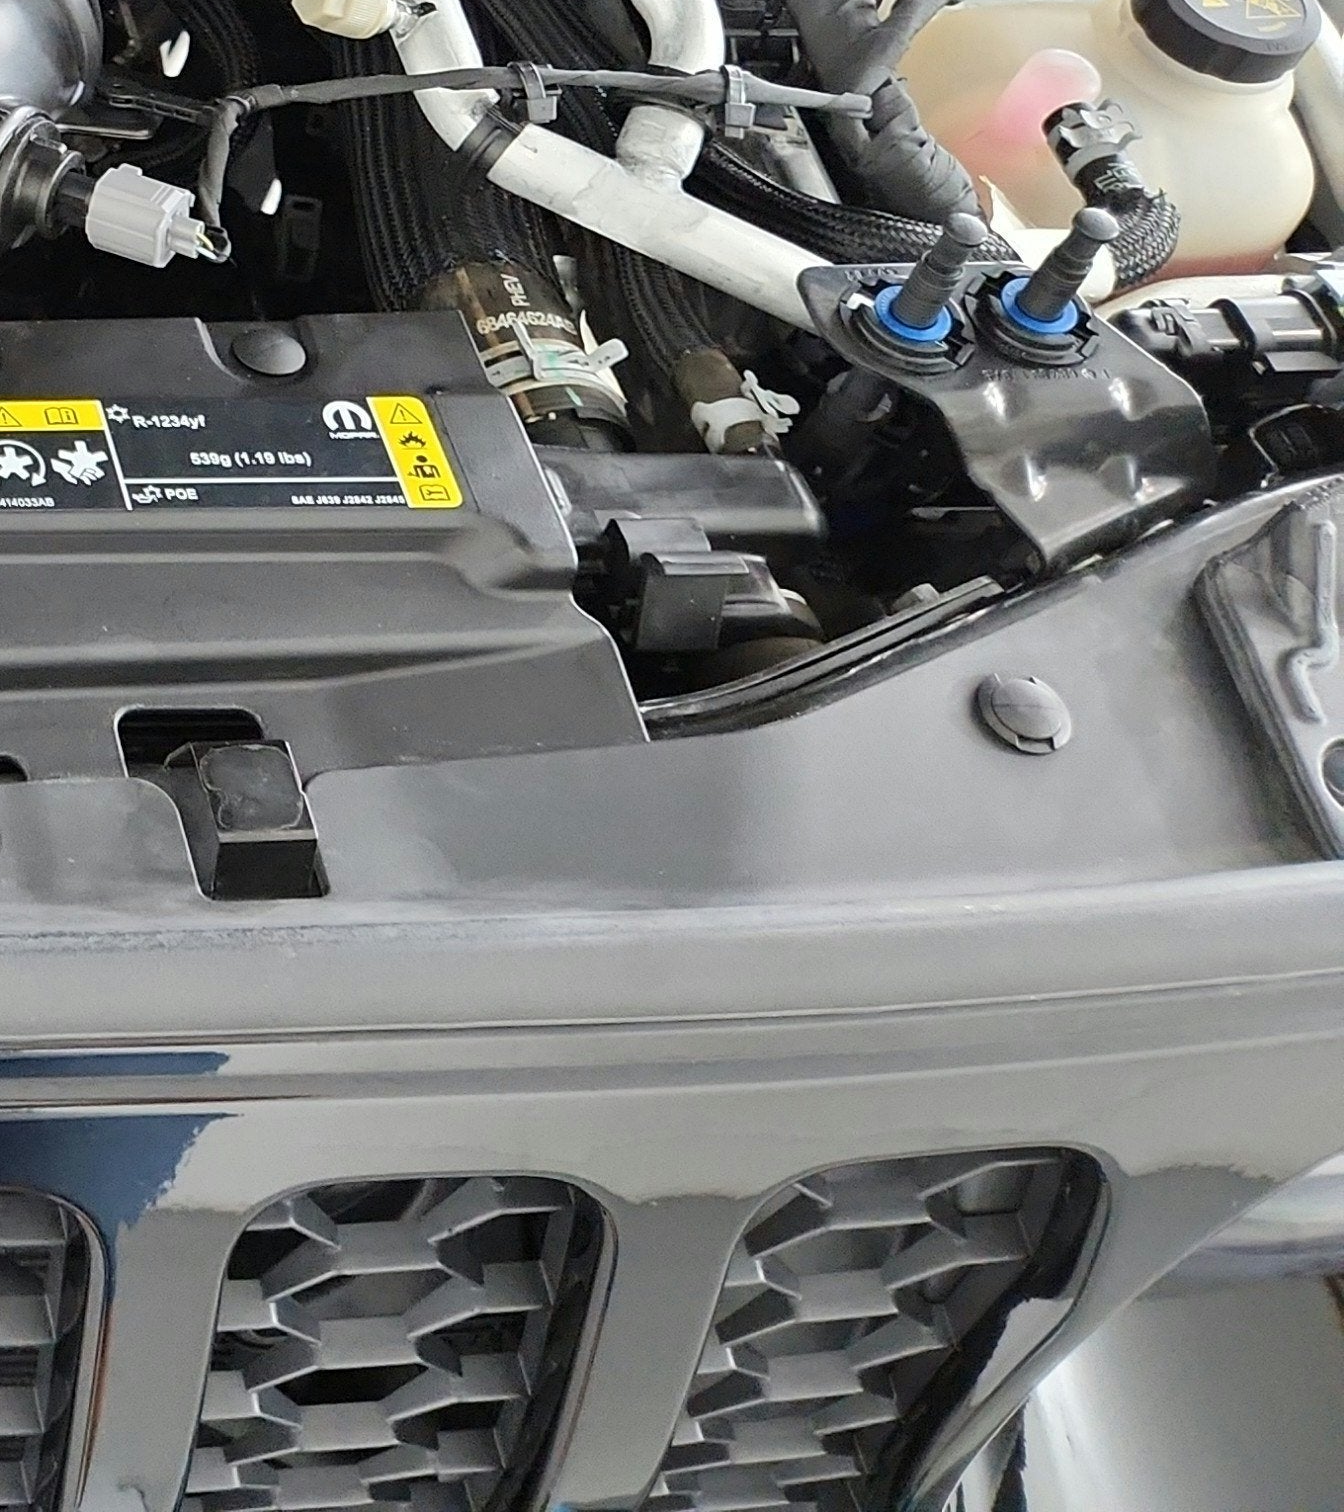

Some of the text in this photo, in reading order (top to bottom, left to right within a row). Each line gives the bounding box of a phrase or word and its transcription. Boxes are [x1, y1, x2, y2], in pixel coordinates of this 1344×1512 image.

[501, 273, 531, 307] PHEV
[132, 414, 206, 430] R-1234yf
[189, 451, 312, 468] 539g (1.19 lbs)
[165, 487, 199, 501] POE
[291, 495, 315, 505] SAE
